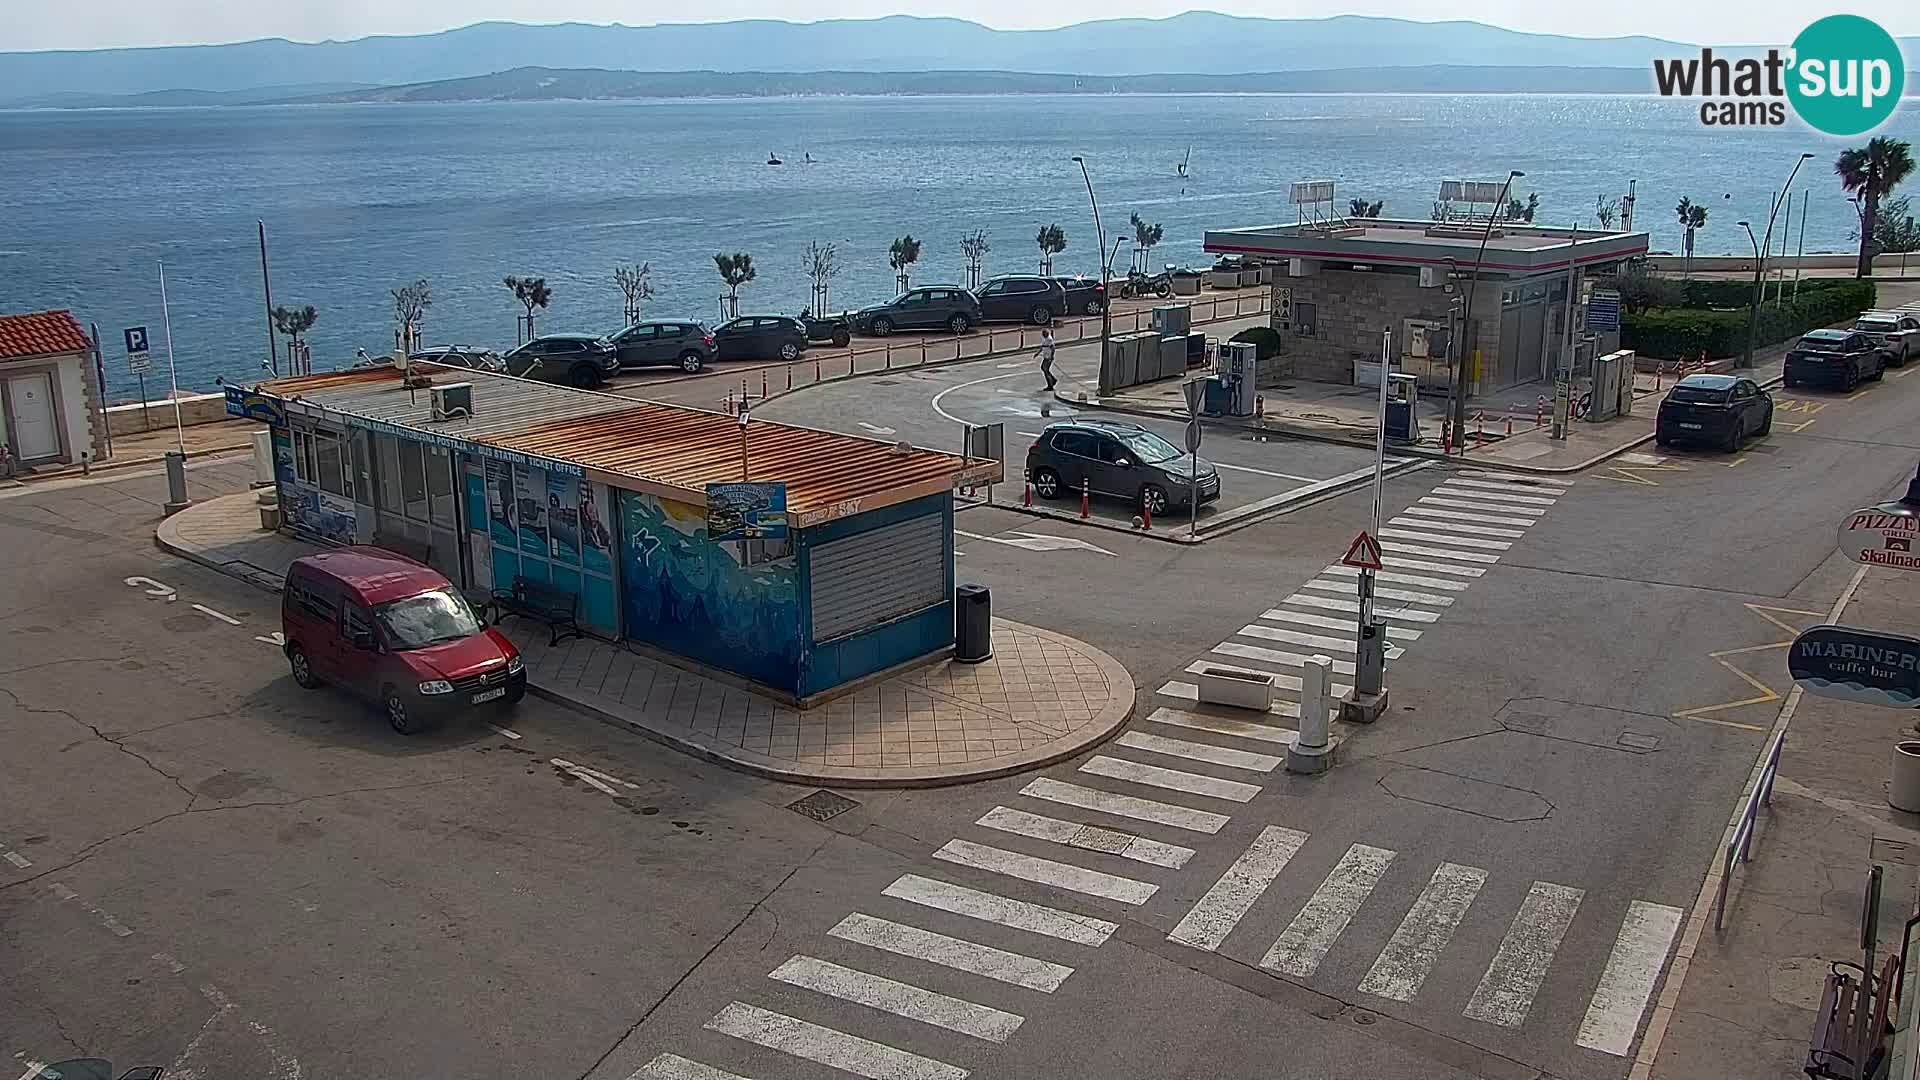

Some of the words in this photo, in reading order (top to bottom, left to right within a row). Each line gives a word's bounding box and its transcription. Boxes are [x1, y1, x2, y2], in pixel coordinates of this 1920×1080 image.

[129, 331, 143, 349] P
[436, 436, 468, 451] POSTAJA
[478, 446, 493, 458] BUS
[494, 448, 526, 465] STATION
[528, 457, 554, 470] TICKET
[555, 462, 583, 477] OFFICE
[1881, 530, 1917, 540] GRILL
[1828, 661, 1866, 675] caffe
[1870, 664, 1897, 680] bar
